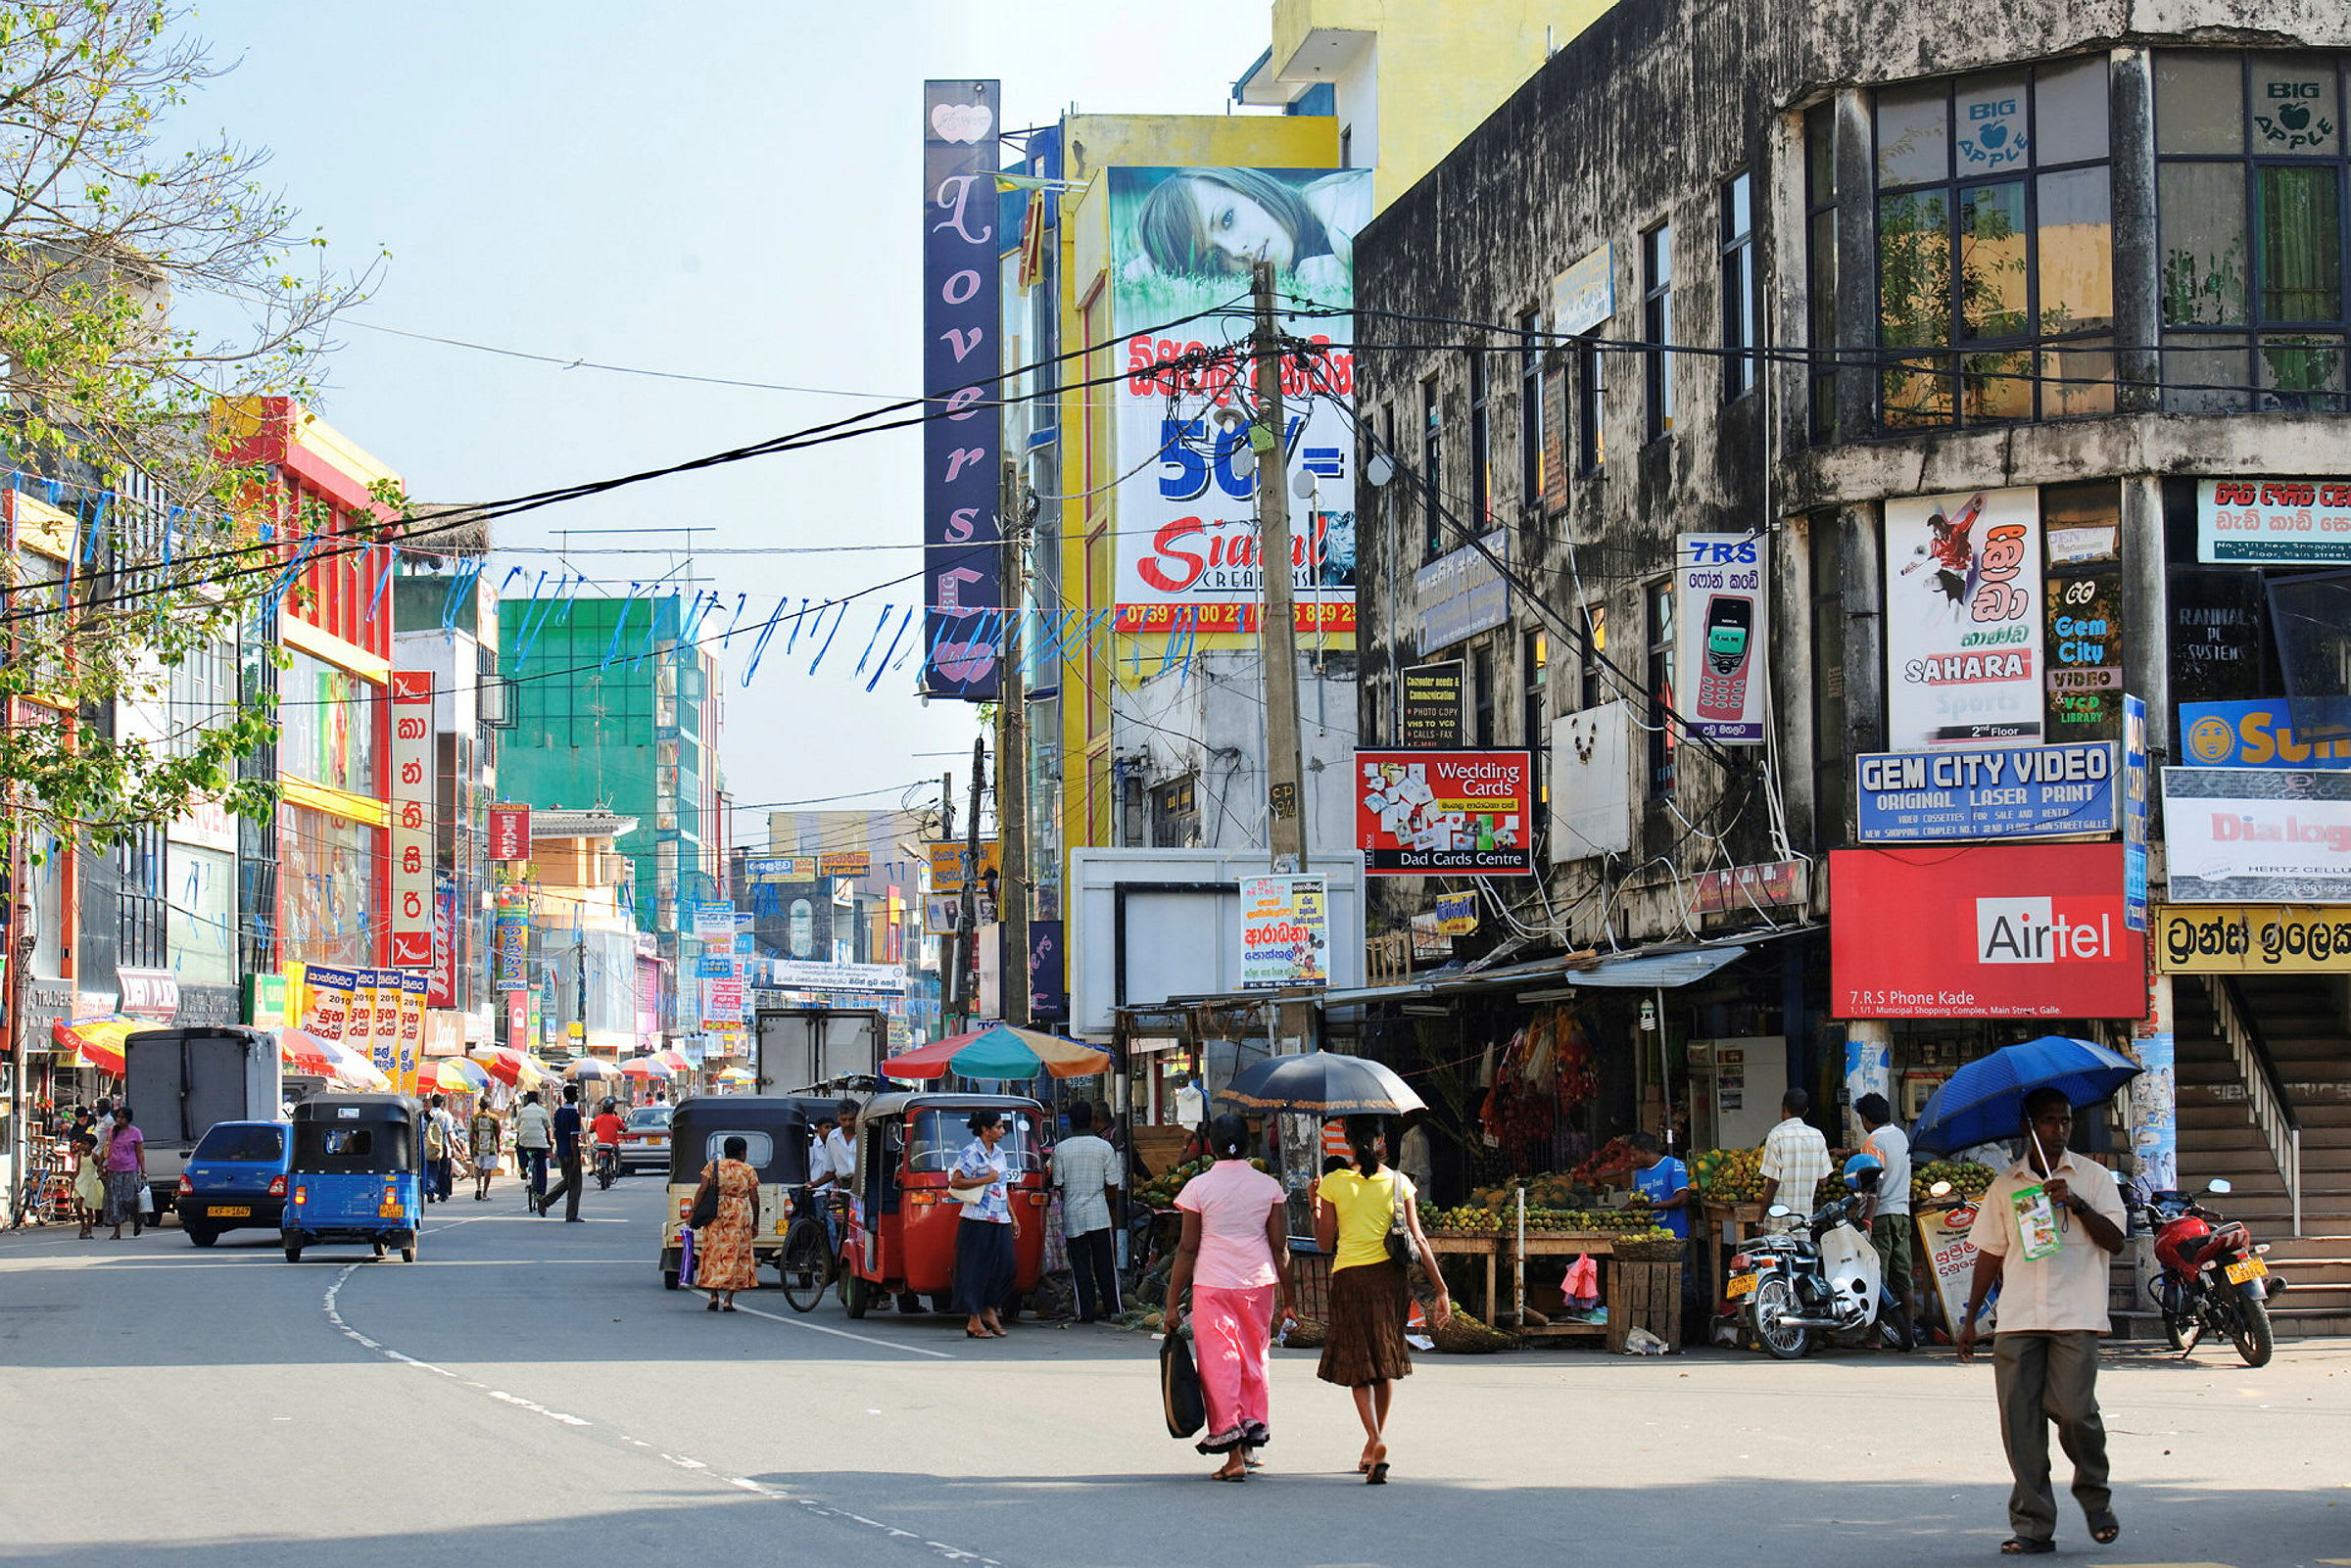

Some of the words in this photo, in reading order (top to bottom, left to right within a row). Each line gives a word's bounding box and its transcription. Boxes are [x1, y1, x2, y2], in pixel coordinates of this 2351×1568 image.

[2268, 82, 2320, 98] BIG
[1969, 99, 2016, 120] BIG
[2254, 116, 2333, 150] APPLE
[1957, 131, 2028, 167] APPLE
[2215, 483, 2256, 505] DAD
[2259, 484, 2316, 506] CARD
[1690, 542, 1757, 564] 7RS
[2055, 616, 2107, 637] Gem
[2059, 641, 2103, 664] City
[1905, 653, 2024, 684] SAHARA
[2053, 671, 2111, 688] VIDEO
[2064, 696, 2100, 709] VCD
[2061, 712, 2103, 724] LIBRARY
[1972, 725, 1990, 737] 2nd
[1991, 727, 2020, 736] Floor
[1437, 762, 1520, 783] Wedding
[1862, 757, 1926, 791] GEM
[1933, 753, 2004, 786] CITY
[2013, 747, 2107, 783] VIDEO
[1463, 781, 1513, 796] Cards
[1876, 791, 1955, 811] ORIGINAL
[1969, 786, 2028, 807] LASER
[2041, 784, 2094, 803] PRINT
[1994, 810, 2013, 820] SALE
[2018, 809, 2033, 819] AND
[2211, 813, 2351, 852] Dialog
[1401, 853, 1428, 866] Dad
[1433, 853, 1472, 866] Cards
[1476, 853, 1522, 866] Centre
[1985, 912, 2110, 959] Airtel
[329, 995, 351, 1005] 2010
[404, 999, 423, 1008] 2010
[1850, 991, 1885, 1005] 7.R.S
[1891, 991, 1934, 1005] Phone
[1939, 991, 1975, 1005] Kade
[1876, 1006, 1912, 1015] Municipal
[1915, 1007, 1950, 1017] Shopping
